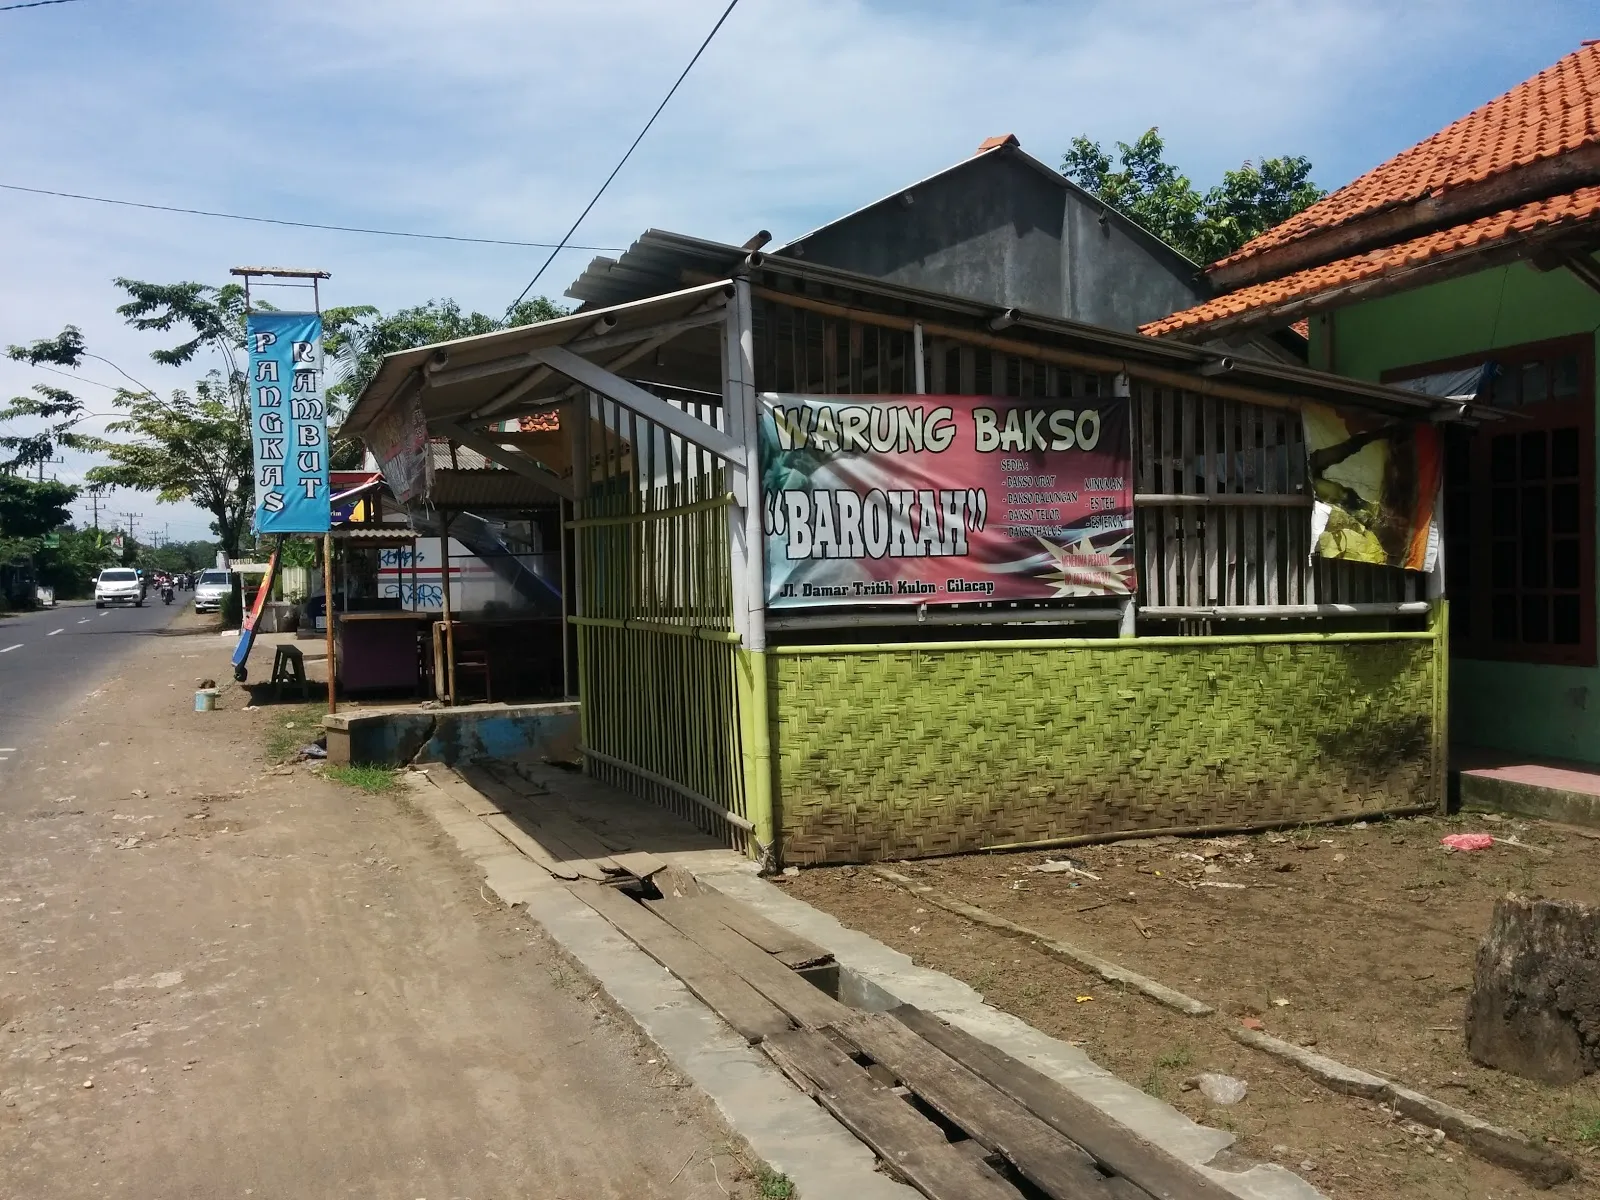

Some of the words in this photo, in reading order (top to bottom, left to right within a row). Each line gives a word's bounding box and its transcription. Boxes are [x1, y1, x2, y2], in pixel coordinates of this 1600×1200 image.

[253, 331, 285, 513] PANGKAS
[290, 340, 324, 499] RAMBUT
[773, 404, 956, 454] WARUNG
[972, 406, 1101, 453] BAKSO
[779, 583, 798, 598] Jl.
[802, 582, 849, 597] Damar
[852, 580, 893, 596] Tritih
[897, 579, 936, 595] Kulon
[946, 578, 995, 595] Cilacap
